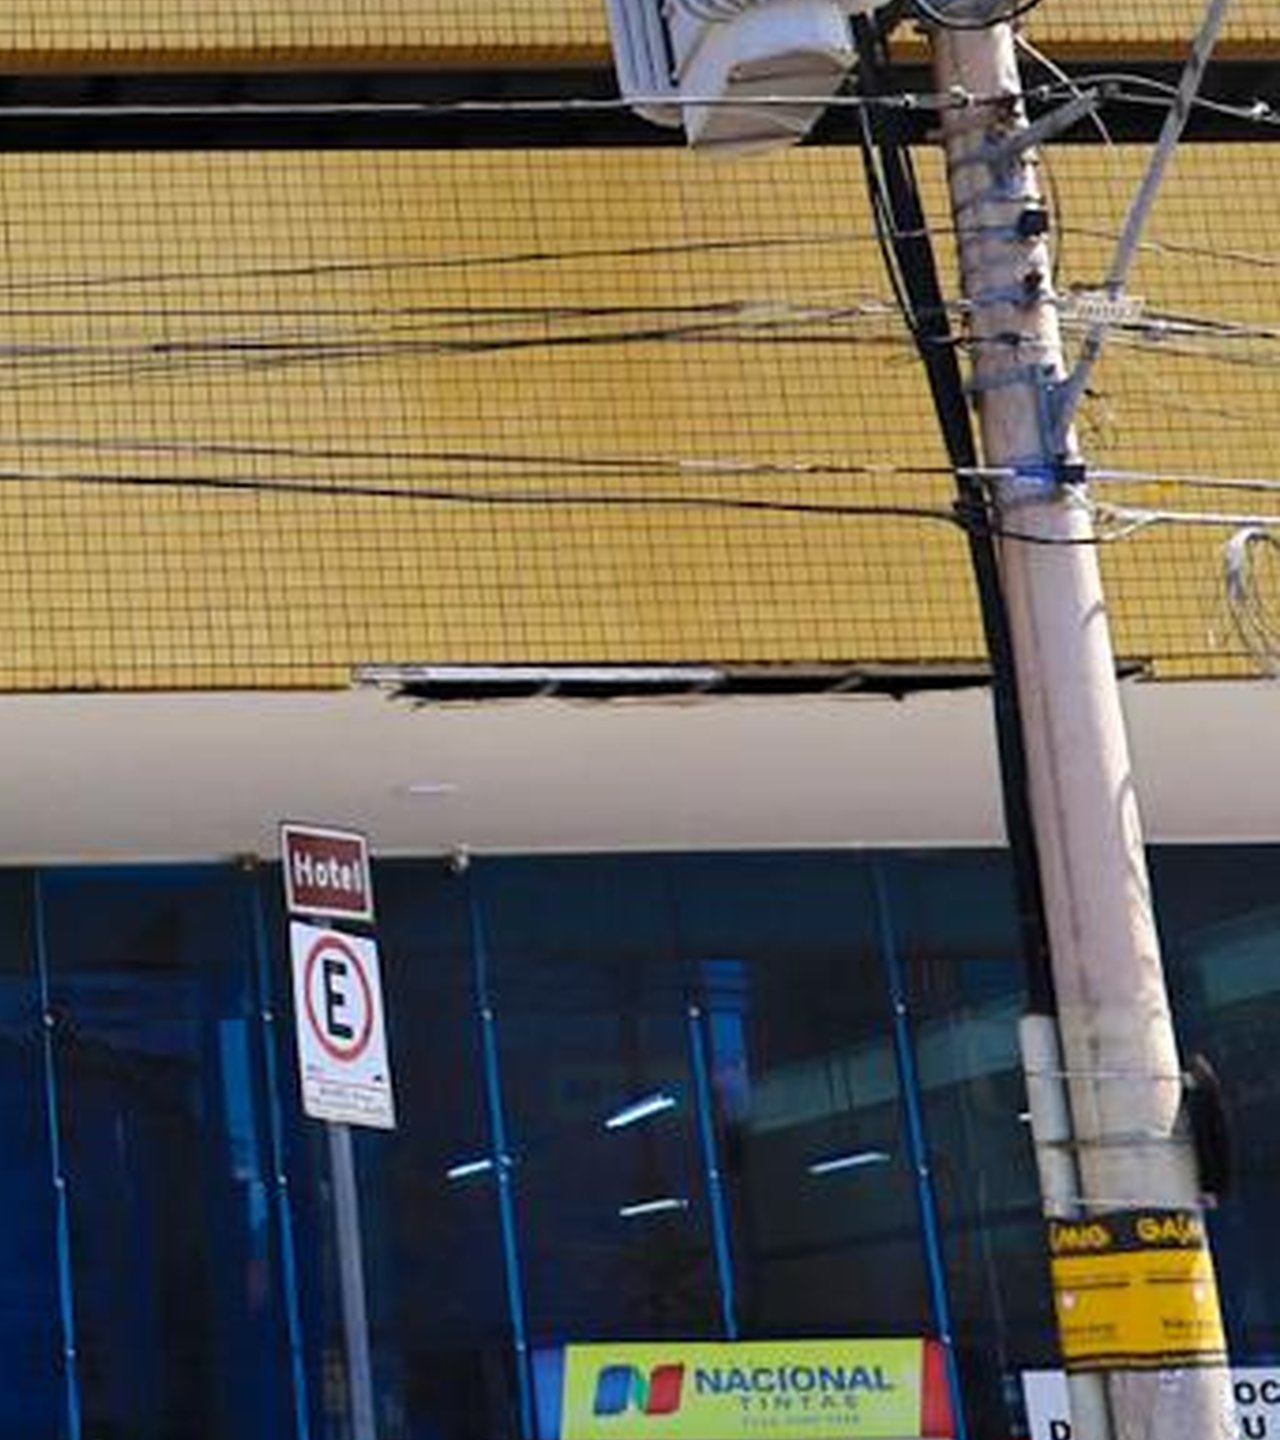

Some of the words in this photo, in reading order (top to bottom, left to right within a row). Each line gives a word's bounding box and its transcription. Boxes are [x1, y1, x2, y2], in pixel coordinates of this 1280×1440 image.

[293, 850, 363, 894] Hotel
[323, 959, 354, 1039] E
[694, 1365, 896, 1394] NACIONAL
[741, 1394, 859, 1411] TINTAS
